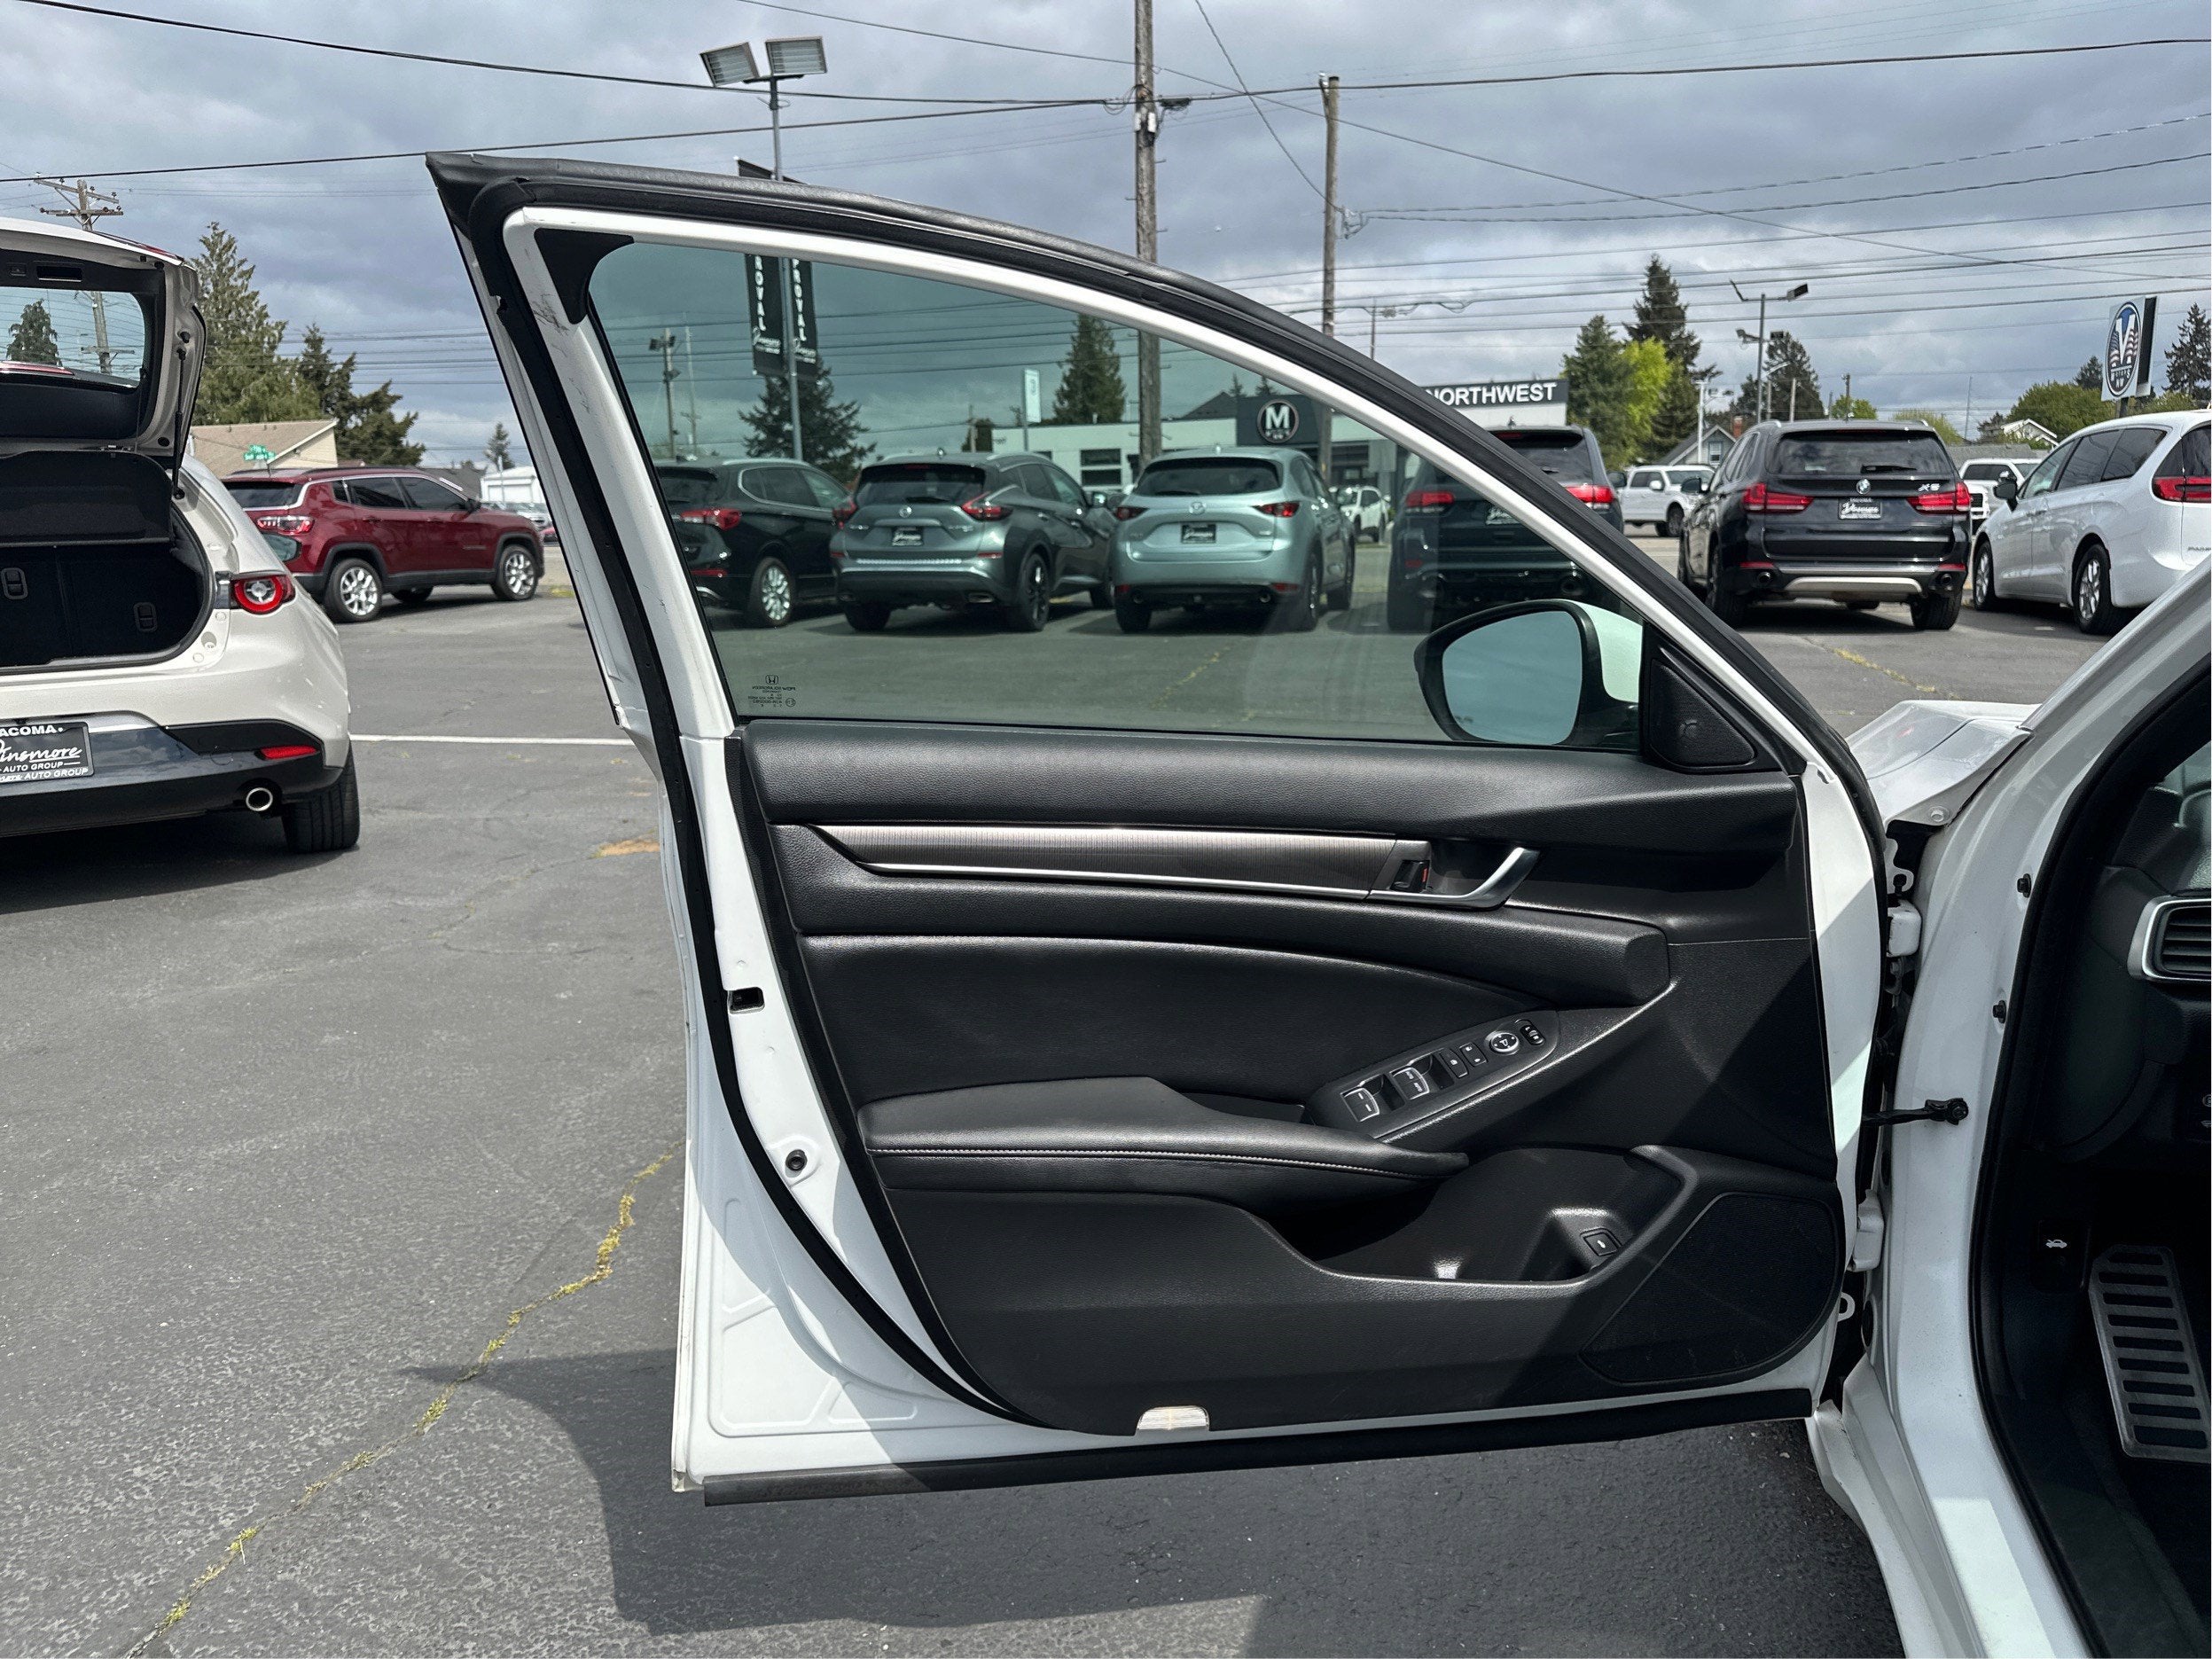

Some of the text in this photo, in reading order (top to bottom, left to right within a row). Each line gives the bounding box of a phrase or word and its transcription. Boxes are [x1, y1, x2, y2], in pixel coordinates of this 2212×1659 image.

[1425, 382, 1558, 406] NORTHWEST
[1265, 405, 1290, 429] M
[3, 761, 64, 773] AUTO GROUP
[24, 771, 51, 780] AUTO
[53, 767, 89, 777] GROUP
